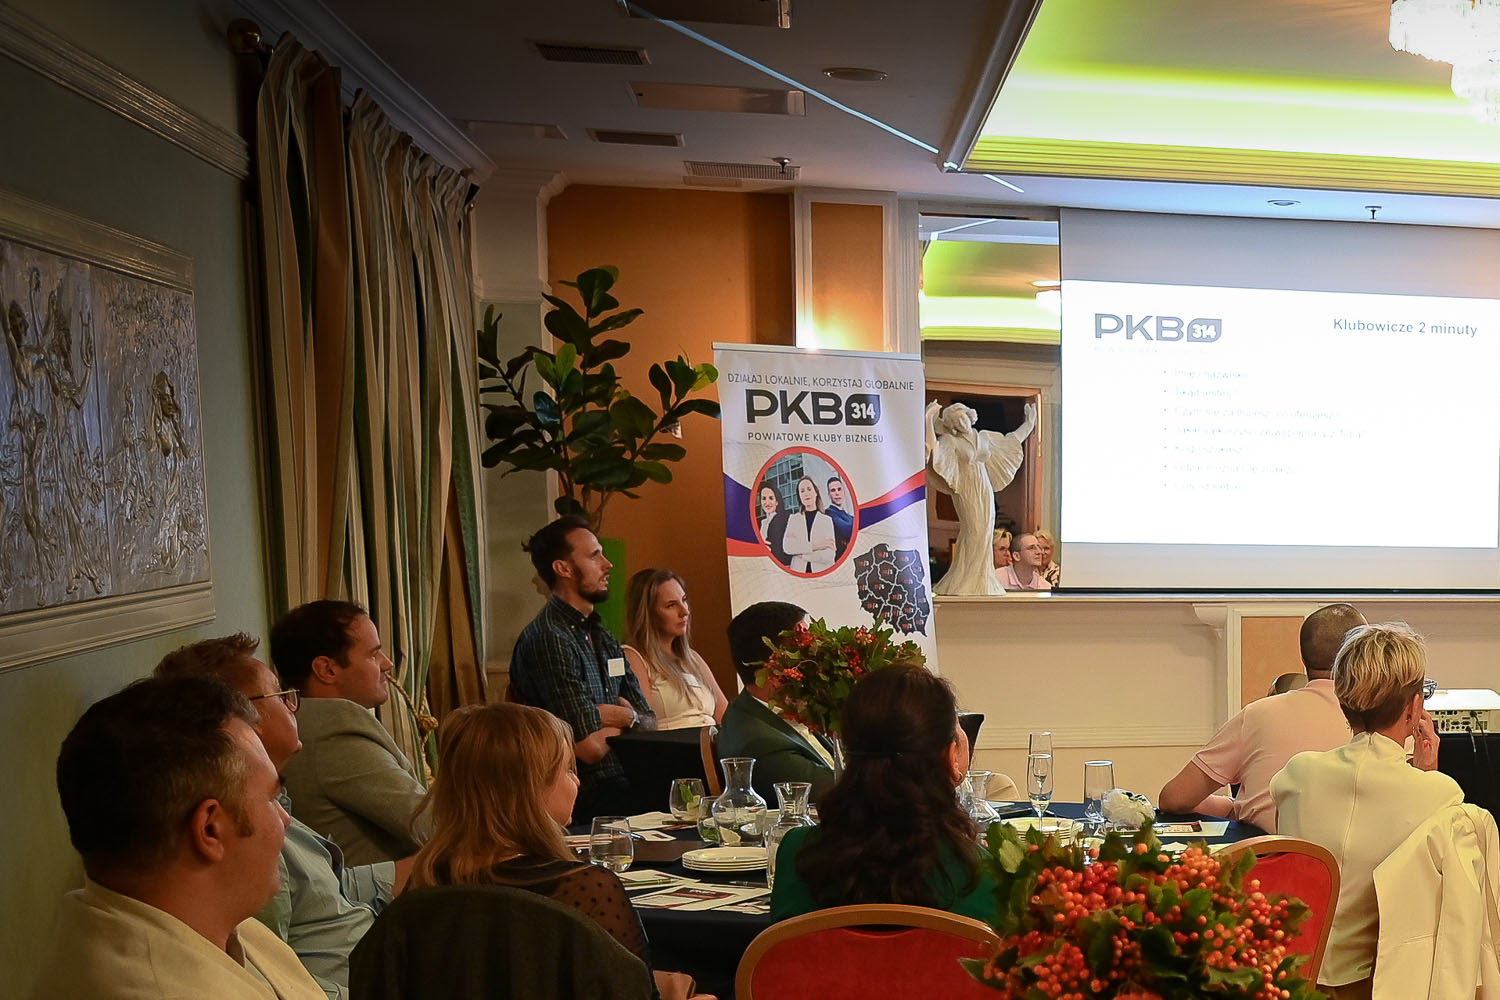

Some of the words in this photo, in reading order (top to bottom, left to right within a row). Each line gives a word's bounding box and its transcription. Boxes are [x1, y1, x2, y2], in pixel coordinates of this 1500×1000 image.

[1094, 313, 1185, 342] PKB
[1192, 323, 1217, 340] 314
[1333, 318, 1413, 334] Klubowicze
[1418, 321, 1427, 334] 2
[1431, 321, 1478, 338] minuty
[728, 373, 762, 383] DZIAŁAJ
[765, 375, 811, 387] LOKALNIE,
[813, 377, 862, 388] KORZYSTAJ
[865, 379, 914, 391] GLOBALNIE
[745, 389, 843, 425] PKB
[851, 402, 876, 419] 314
[748, 432, 810, 442] POWIATOWE
[813, 433, 842, 443] KLUBY
[846, 434, 883, 443] BIZNESU
